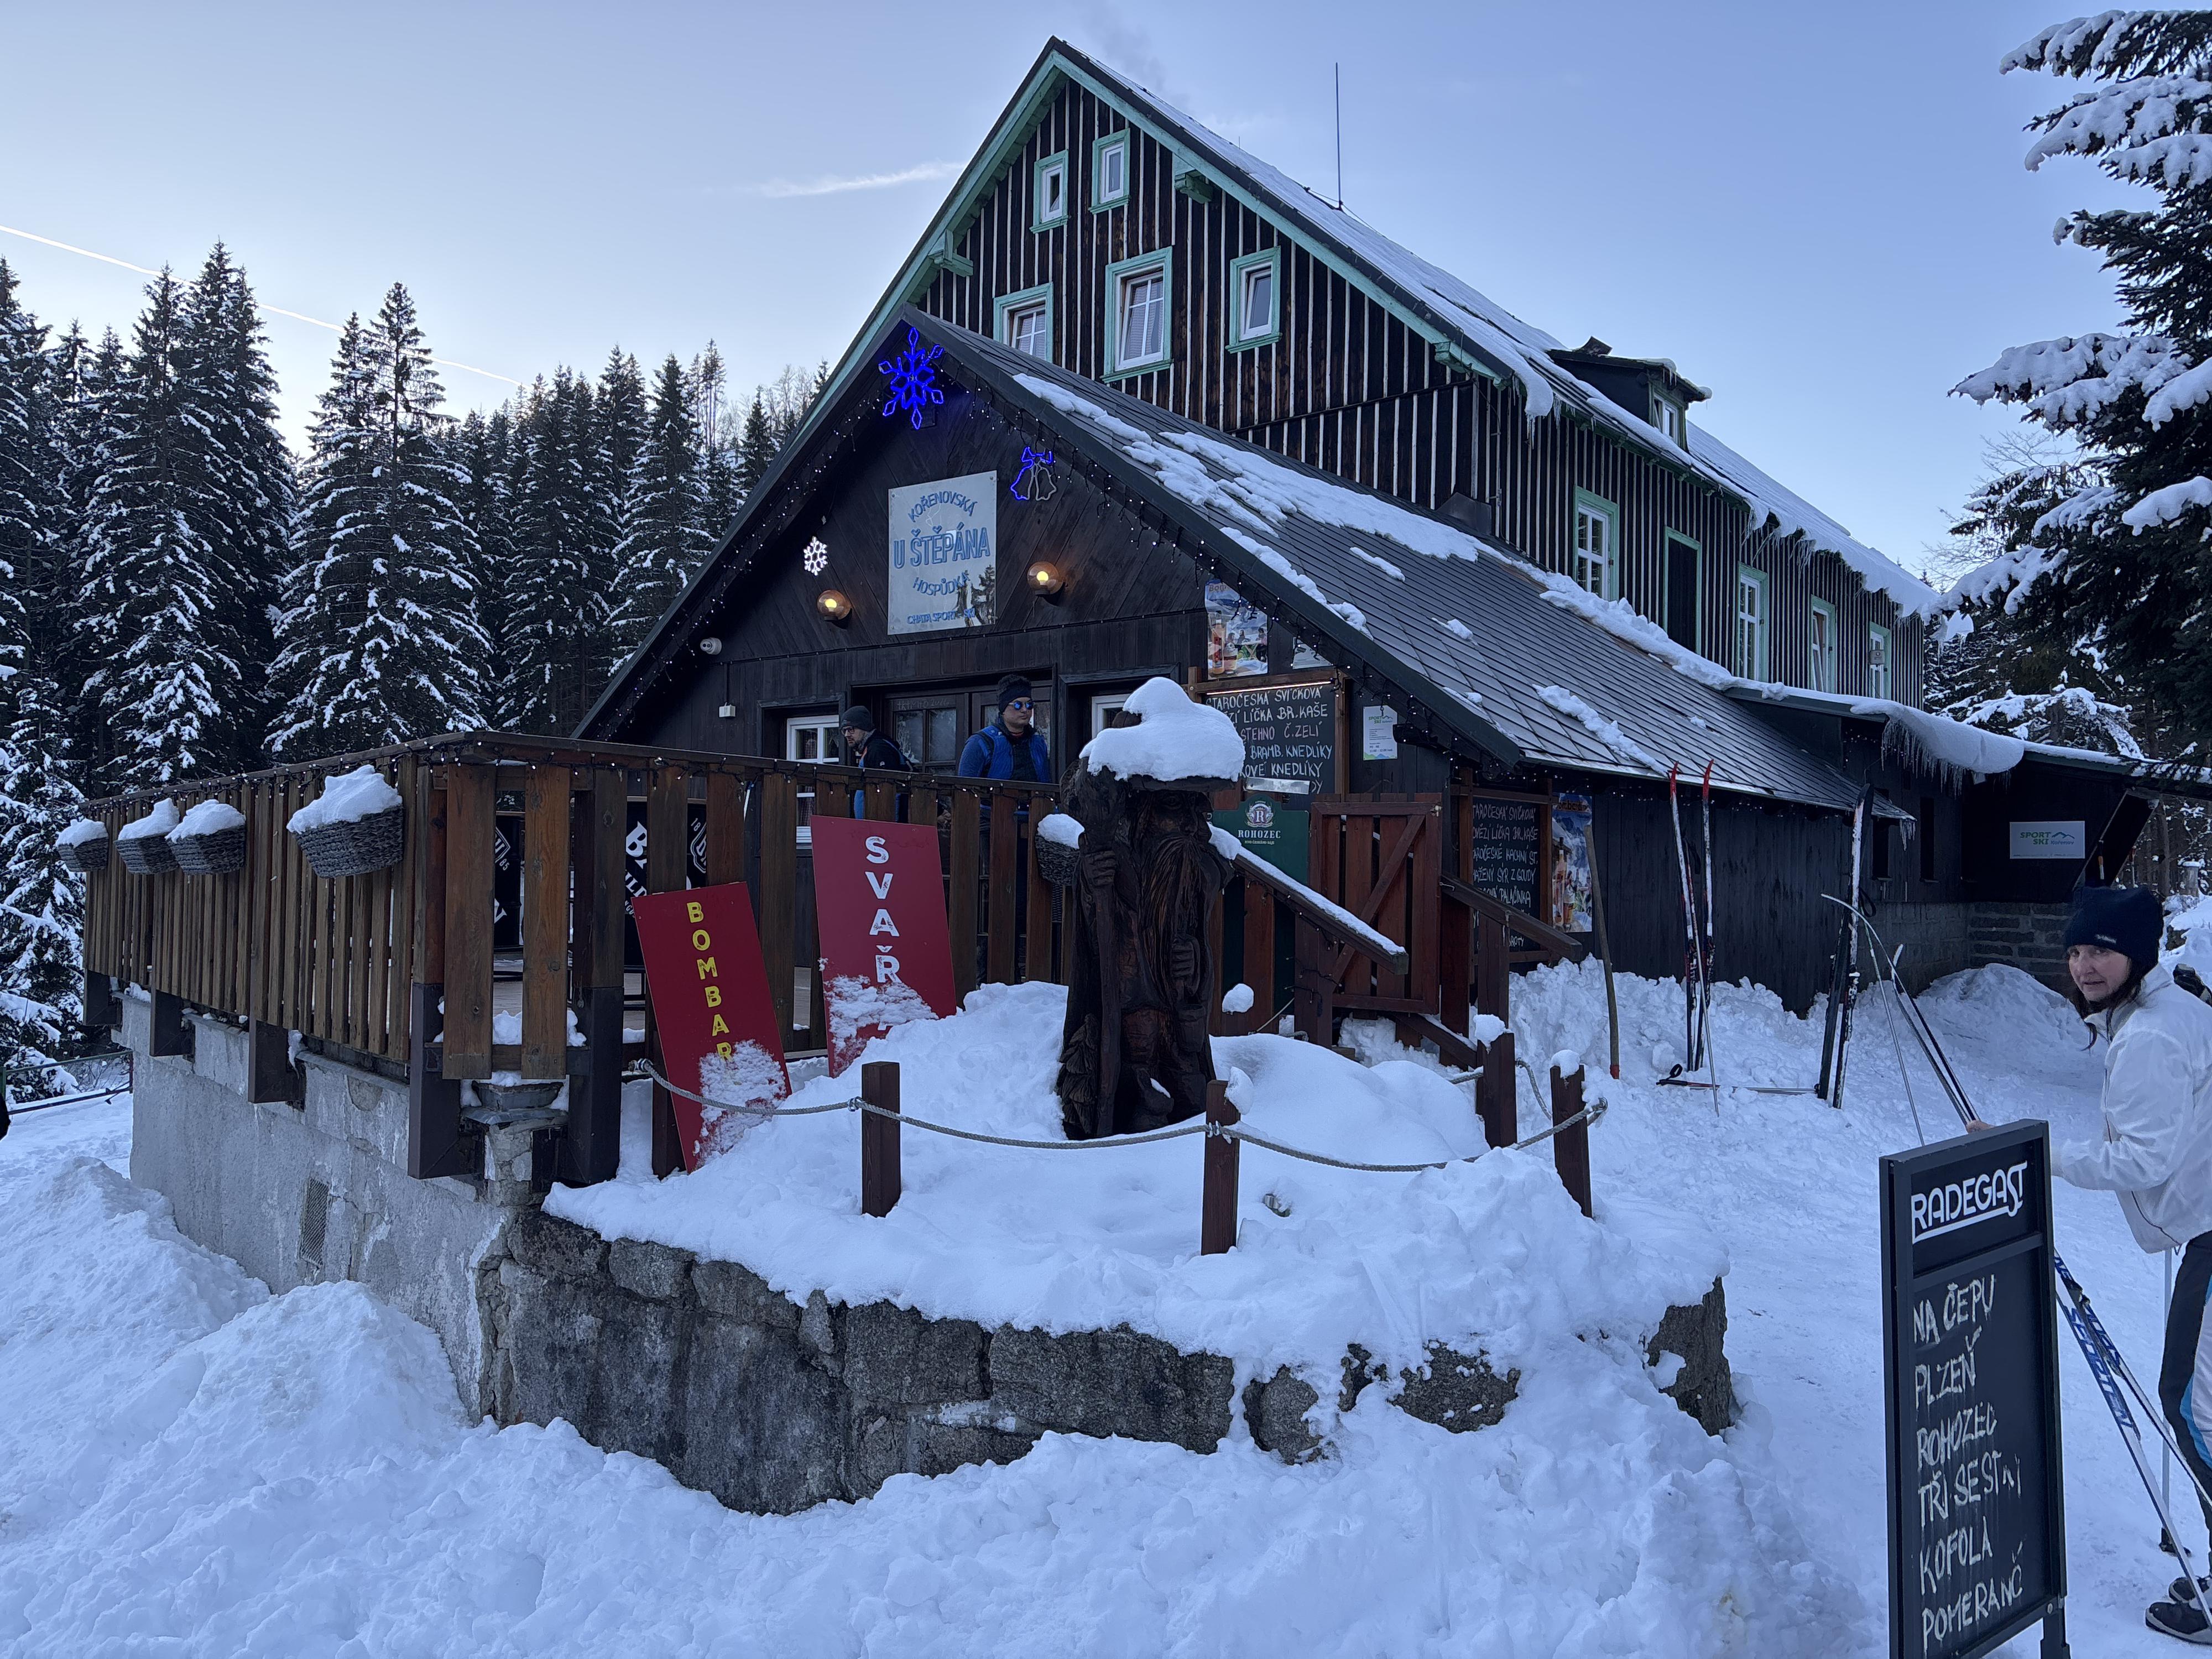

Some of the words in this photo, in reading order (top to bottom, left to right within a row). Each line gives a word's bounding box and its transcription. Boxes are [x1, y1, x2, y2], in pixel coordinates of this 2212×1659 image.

[908, 491, 978, 523] KOŘENOVSKÁ
[894, 540, 905, 569] U
[910, 521, 990, 567] ŠTĚPÁNA
[912, 571, 969, 596] HOSPŮDKA
[907, 613, 931, 624] CHATA
[932, 610, 956, 622] SPORT
[1244, 707, 1273, 723] LÍČKA
[1240, 726, 1275, 742] STEHNO
[1285, 741, 1333, 759] KNEDLÍKY
[1271, 760, 1323, 778] KNEDLÍKY
[1473, 804, 1508, 821] TAROČESKÁ
[1238, 830, 1281, 838] ROHOZEC
[1473, 823, 1491, 841] OVĚZÍ
[1473, 843, 1503, 862] AROČESKÉ
[499, 858, 510, 871] 85
[1473, 865, 1494, 883] AŽENÝ
[1511, 869, 1516, 880] Z
[1516, 867, 1536, 885] GOUDY
[864, 836, 902, 1030] SVAŘ
[686, 901, 734, 1063] BOMBAR
[1911, 1160, 2027, 1244] RADEGAST
[1913, 1299, 1940, 1344] NA
[1943, 1274, 1996, 1331] ČEPU
[1915, 1325, 1982, 1410] PLZEŇ
[1918, 1470, 1949, 1530] TŘI
[1919, 1515, 1993, 1596] KOFOLA
[1922, 1541, 2023, 1656] POMERANČ
